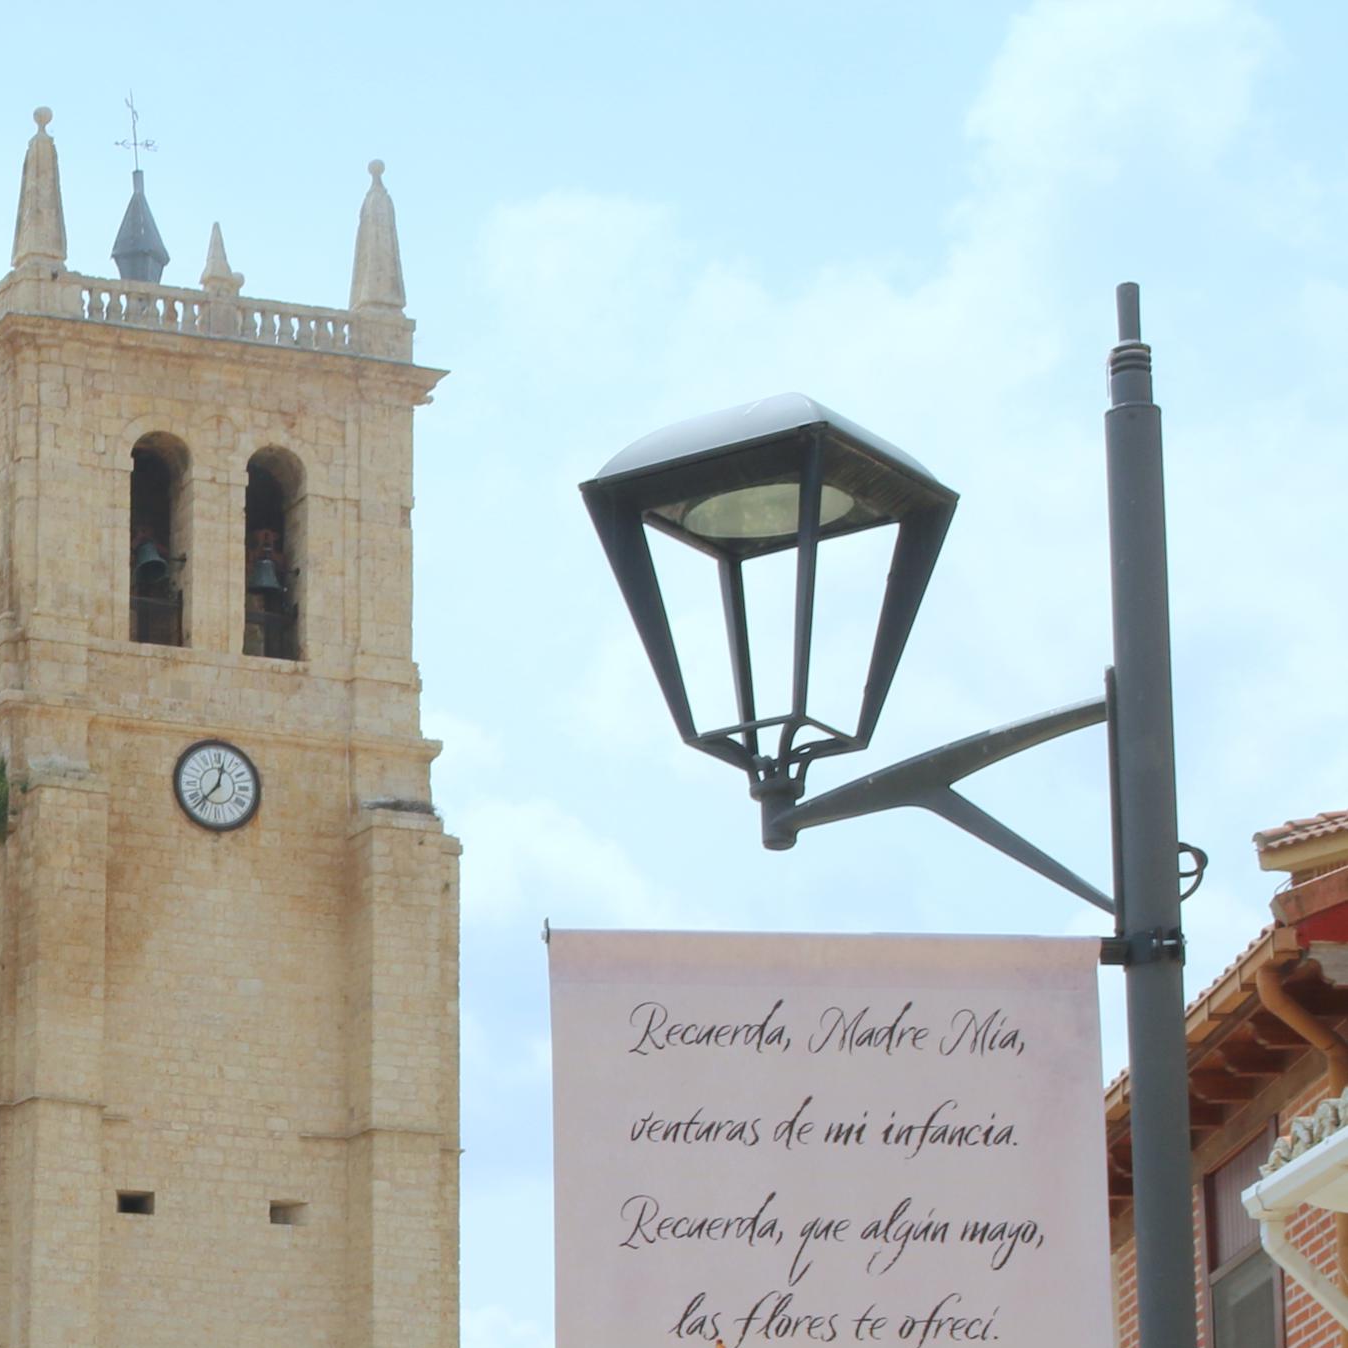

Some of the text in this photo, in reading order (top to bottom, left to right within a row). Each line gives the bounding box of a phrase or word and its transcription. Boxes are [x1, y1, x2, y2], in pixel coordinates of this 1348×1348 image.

[629, 999, 1025, 1056] Recuerda, Madre Mía,
[631, 1096, 1019, 1160] venturas de mi infancia.
[619, 1191, 1045, 1287] Recuerda, que algún mayo,
[669, 1292, 721, 1342] las
[854, 1304, 887, 1342] te
